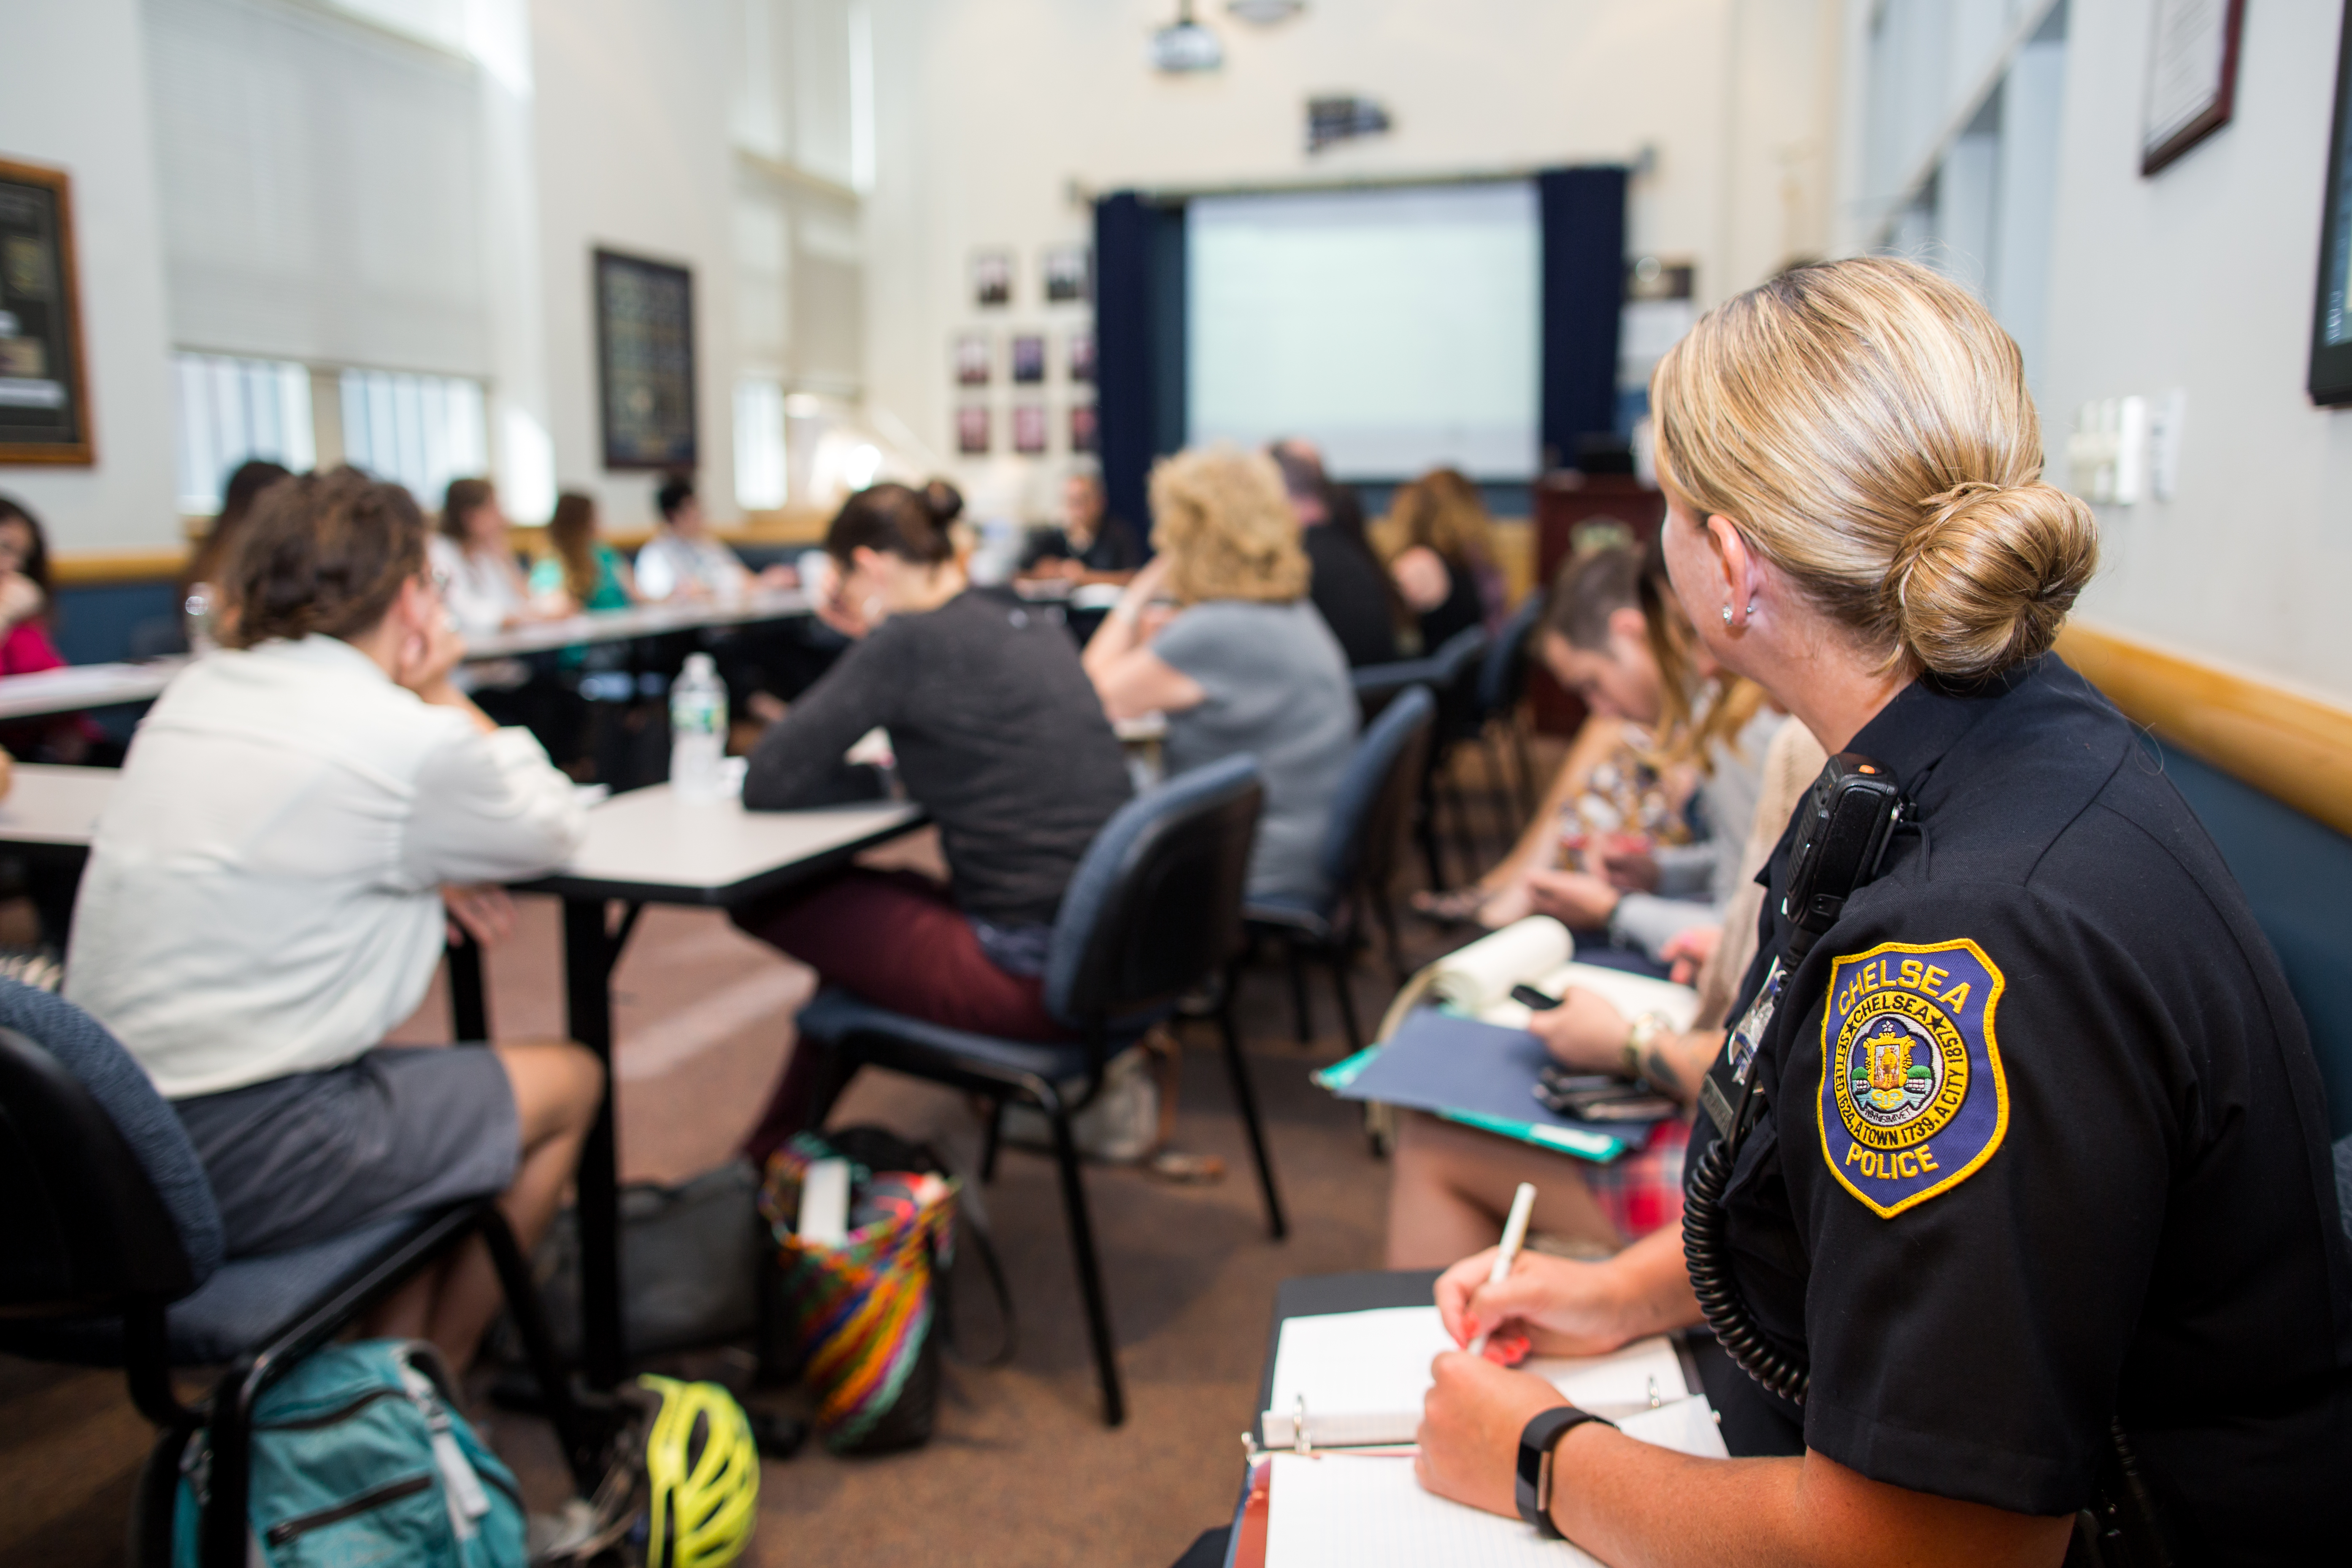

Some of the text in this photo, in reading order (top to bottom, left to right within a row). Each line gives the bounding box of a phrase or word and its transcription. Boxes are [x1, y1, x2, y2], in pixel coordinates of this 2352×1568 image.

[1838, 959, 1971, 1016] CHELSEA
[1854, 995, 1929, 1023] CHELSEA
[1836, 1031, 1964, 1146] SETTLED 1624, A TOWN 1739, A CITY 1857
[1845, 1142, 1939, 1180] POLICE
